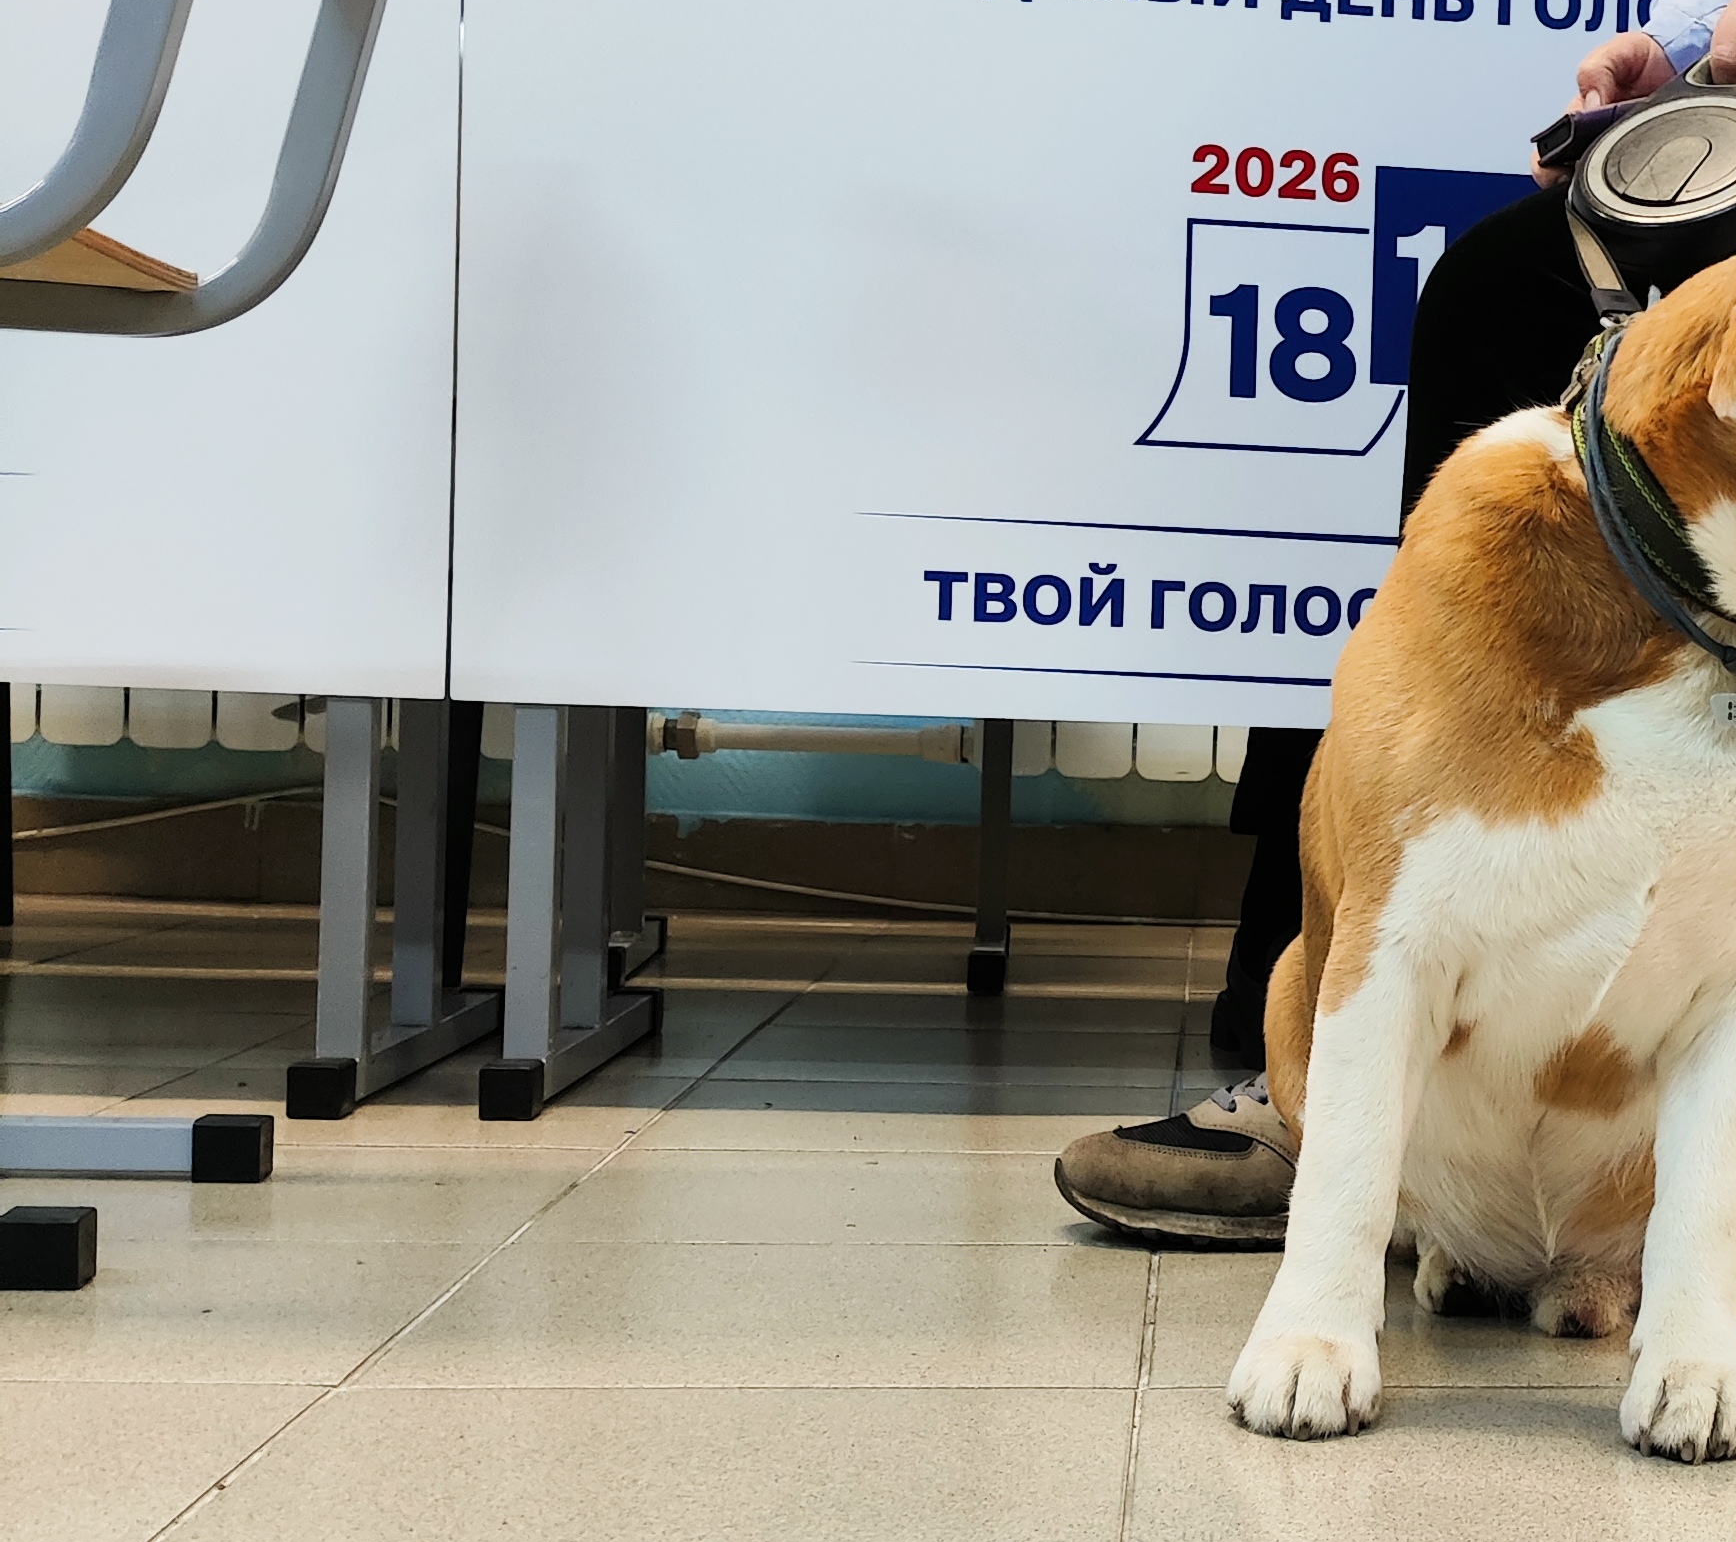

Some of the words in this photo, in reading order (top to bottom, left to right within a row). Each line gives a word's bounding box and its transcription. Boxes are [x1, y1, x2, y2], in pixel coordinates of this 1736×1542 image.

[1191, 144, 1360, 202] 2026
[1209, 283, 1357, 403] 18
[923, 562, 1125, 628] ТВОЙ
